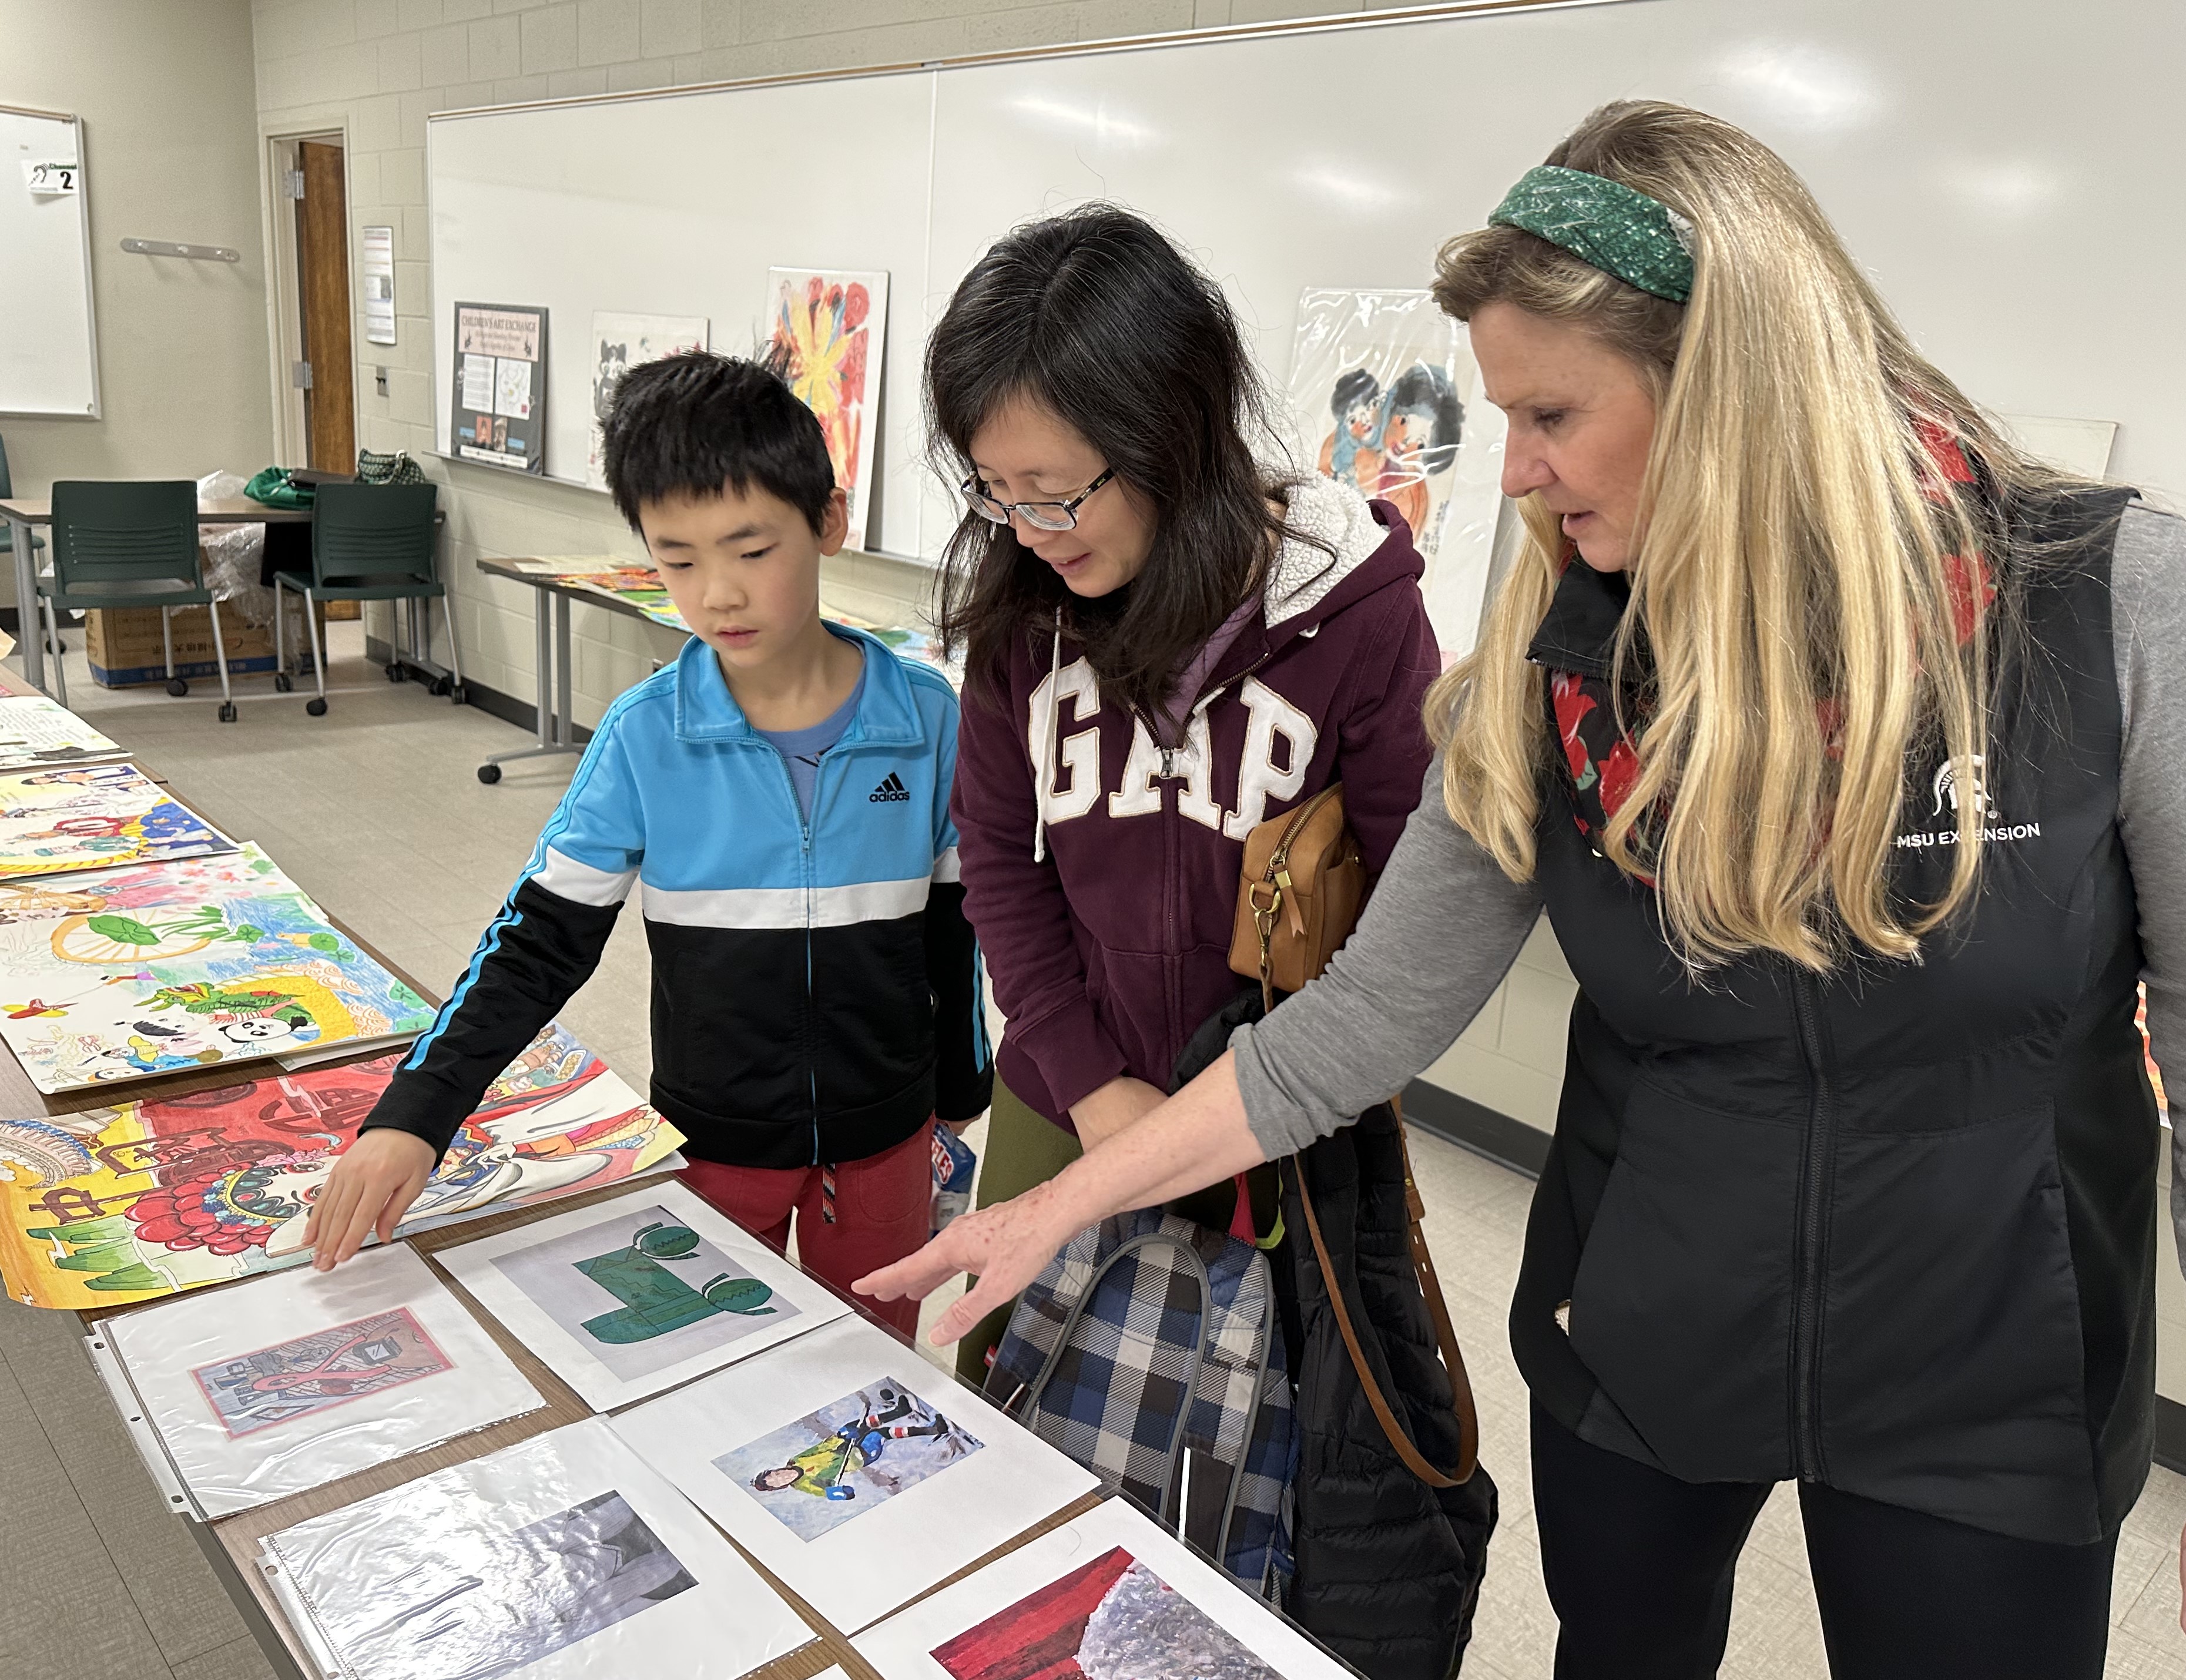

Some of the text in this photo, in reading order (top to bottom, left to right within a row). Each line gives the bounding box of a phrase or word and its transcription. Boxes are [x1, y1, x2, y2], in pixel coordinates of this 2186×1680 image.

[60, 171, 73, 189] 2
[462, 315, 537, 333] CHILDREN'S ART EXCHANGE
[1028, 655, 1319, 842] GAP
[869, 790, 910, 803] adidas
[1897, 822, 2041, 848] MSU EXNSION
